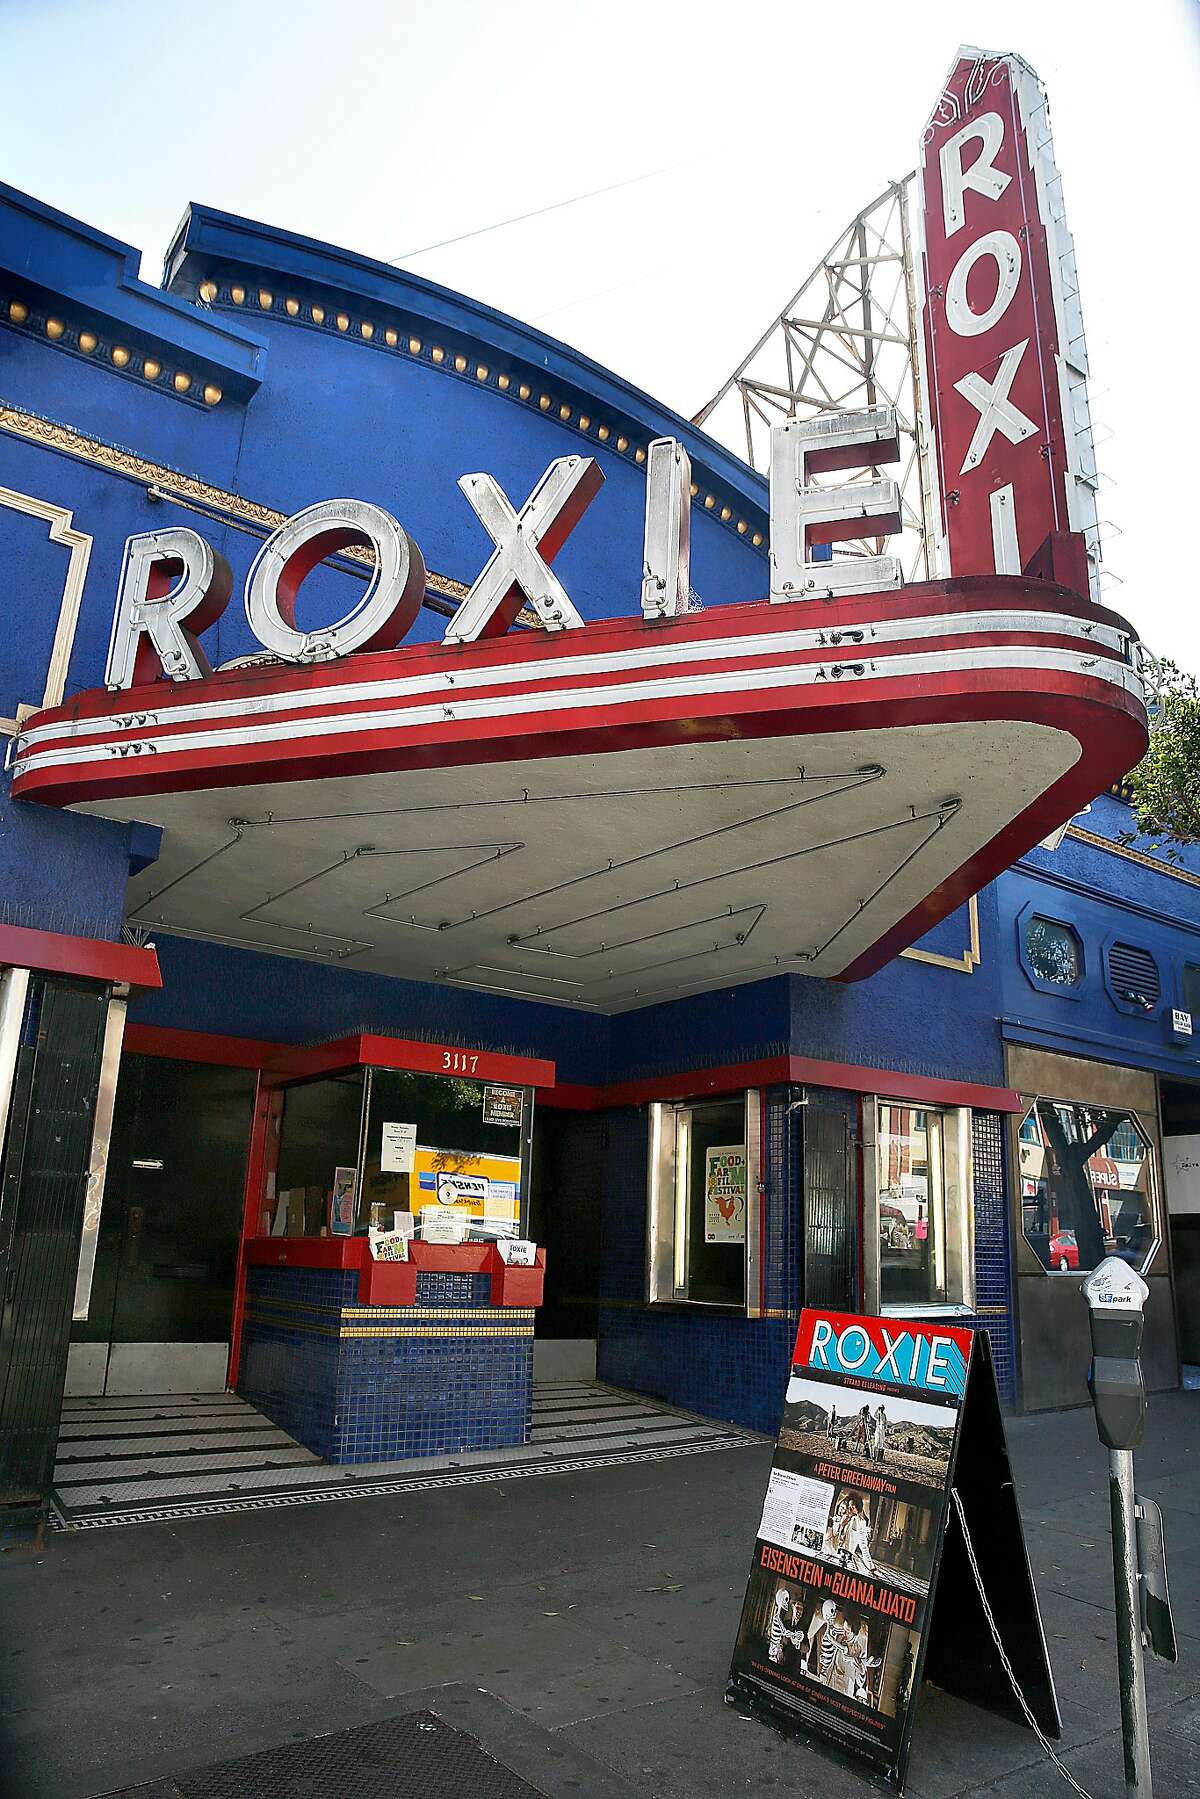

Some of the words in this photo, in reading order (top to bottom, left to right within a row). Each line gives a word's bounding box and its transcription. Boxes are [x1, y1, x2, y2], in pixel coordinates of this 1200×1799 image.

[103, 403, 903, 692] ROXIE
[442, 1051, 479, 1073] 3117
[808, 1319, 954, 1387] ROXIE
[813, 1463, 818, 1473] A
[817, 1462, 841, 1481] PETER
[841, 1469, 887, 1493] GREENAWAY
[885, 1483, 897, 1494] FILM
[760, 1545, 824, 1588] EISENSTEIN
[824, 1573, 833, 1588] IN
[831, 1572, 917, 1624] GUANAJUATO
